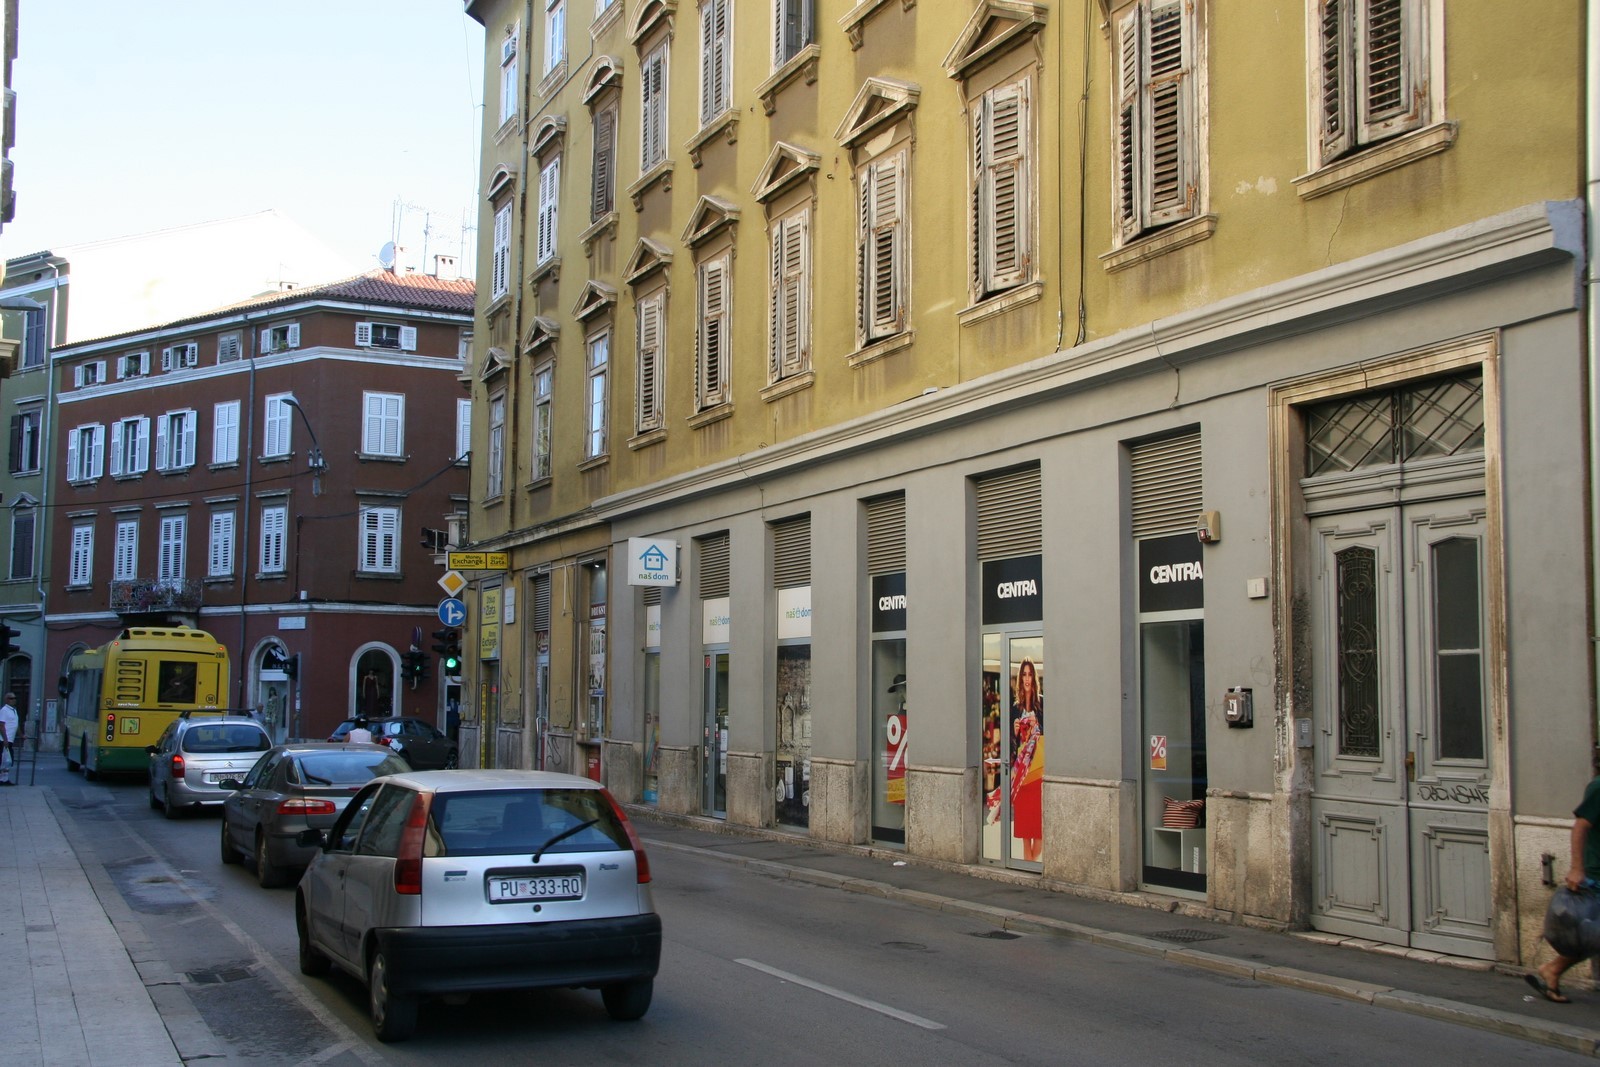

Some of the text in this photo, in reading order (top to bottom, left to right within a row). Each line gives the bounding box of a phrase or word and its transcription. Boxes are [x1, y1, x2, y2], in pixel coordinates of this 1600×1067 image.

[638, 572, 669, 580] naš dom
[1150, 561, 1203, 584] CENTRA
[997, 579, 1037, 599] CENTRA
[879, 594, 907, 611] CENTR
[501, 878, 580, 897] PU 333-RO
